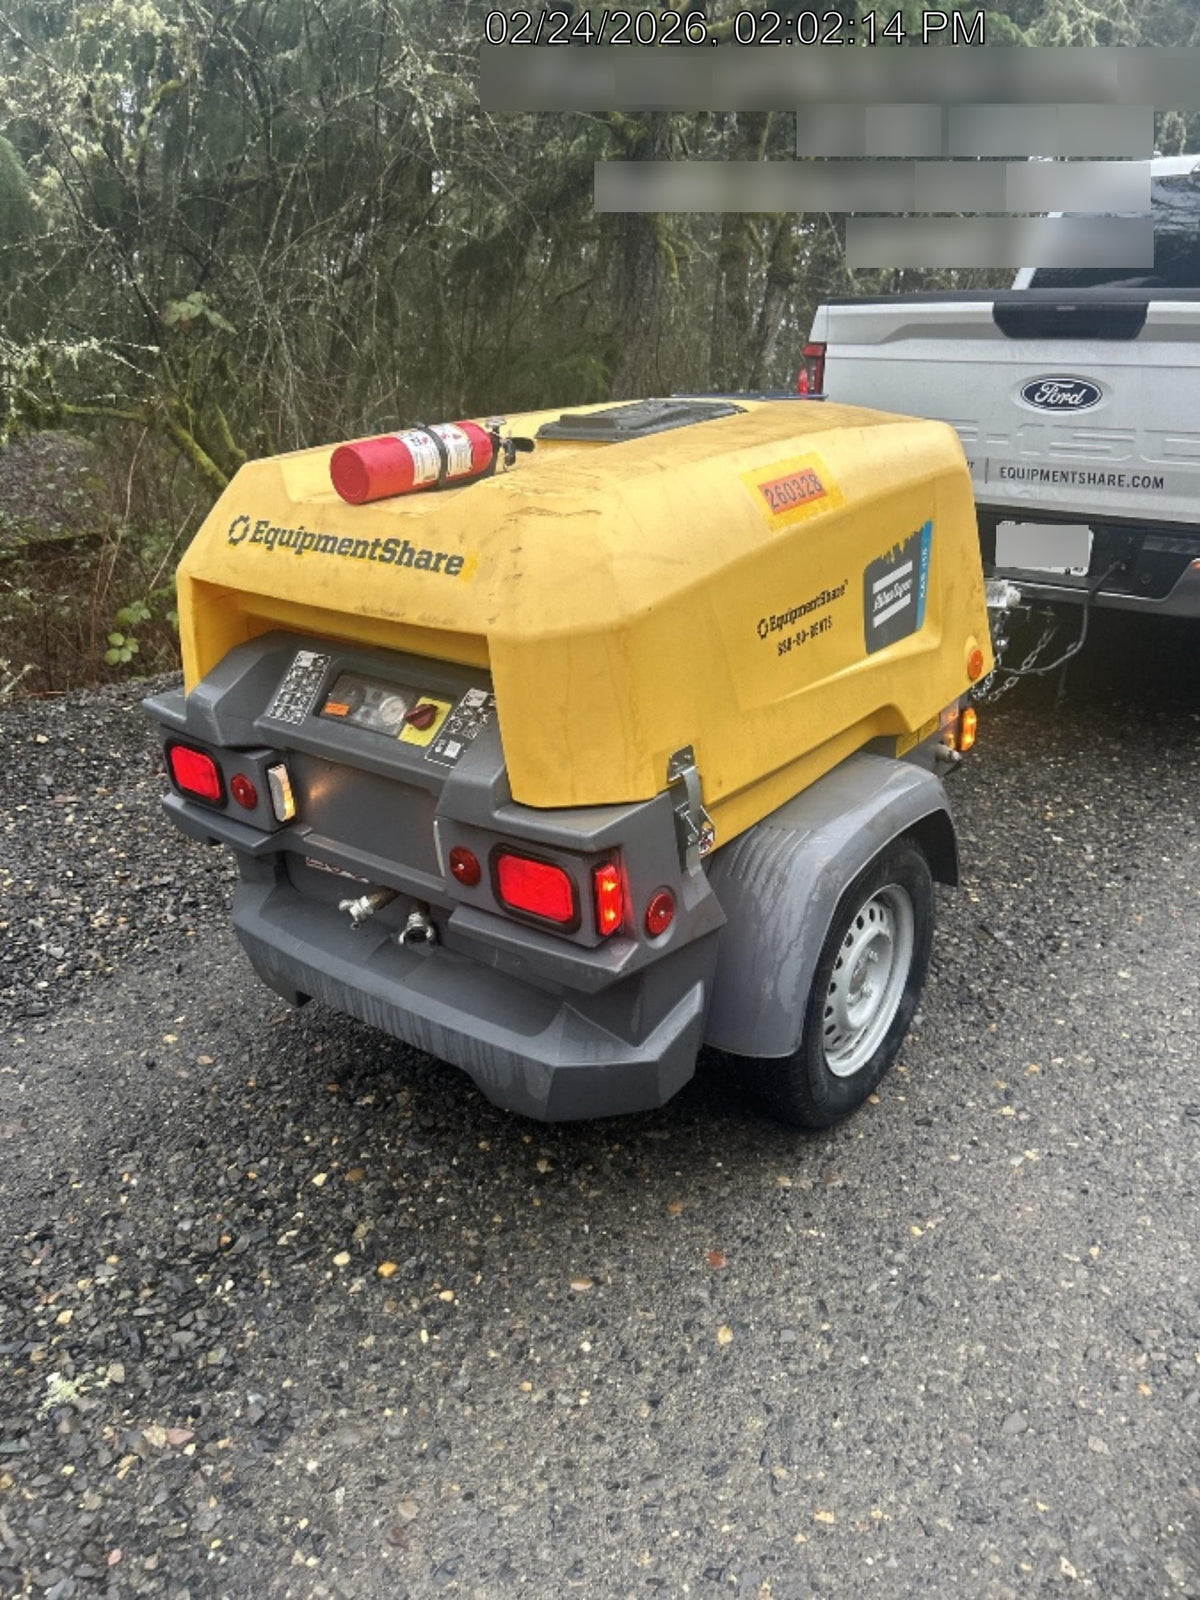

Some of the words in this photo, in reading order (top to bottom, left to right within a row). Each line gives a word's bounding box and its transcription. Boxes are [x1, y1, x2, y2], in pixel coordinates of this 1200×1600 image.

[1034, 382, 1087, 406] Ford
[764, 473, 823, 508] 260328
[1000, 466, 1165, 490] EQUIPMENTSHARE.COM
[250, 519, 465, 577] EquipmentShare
